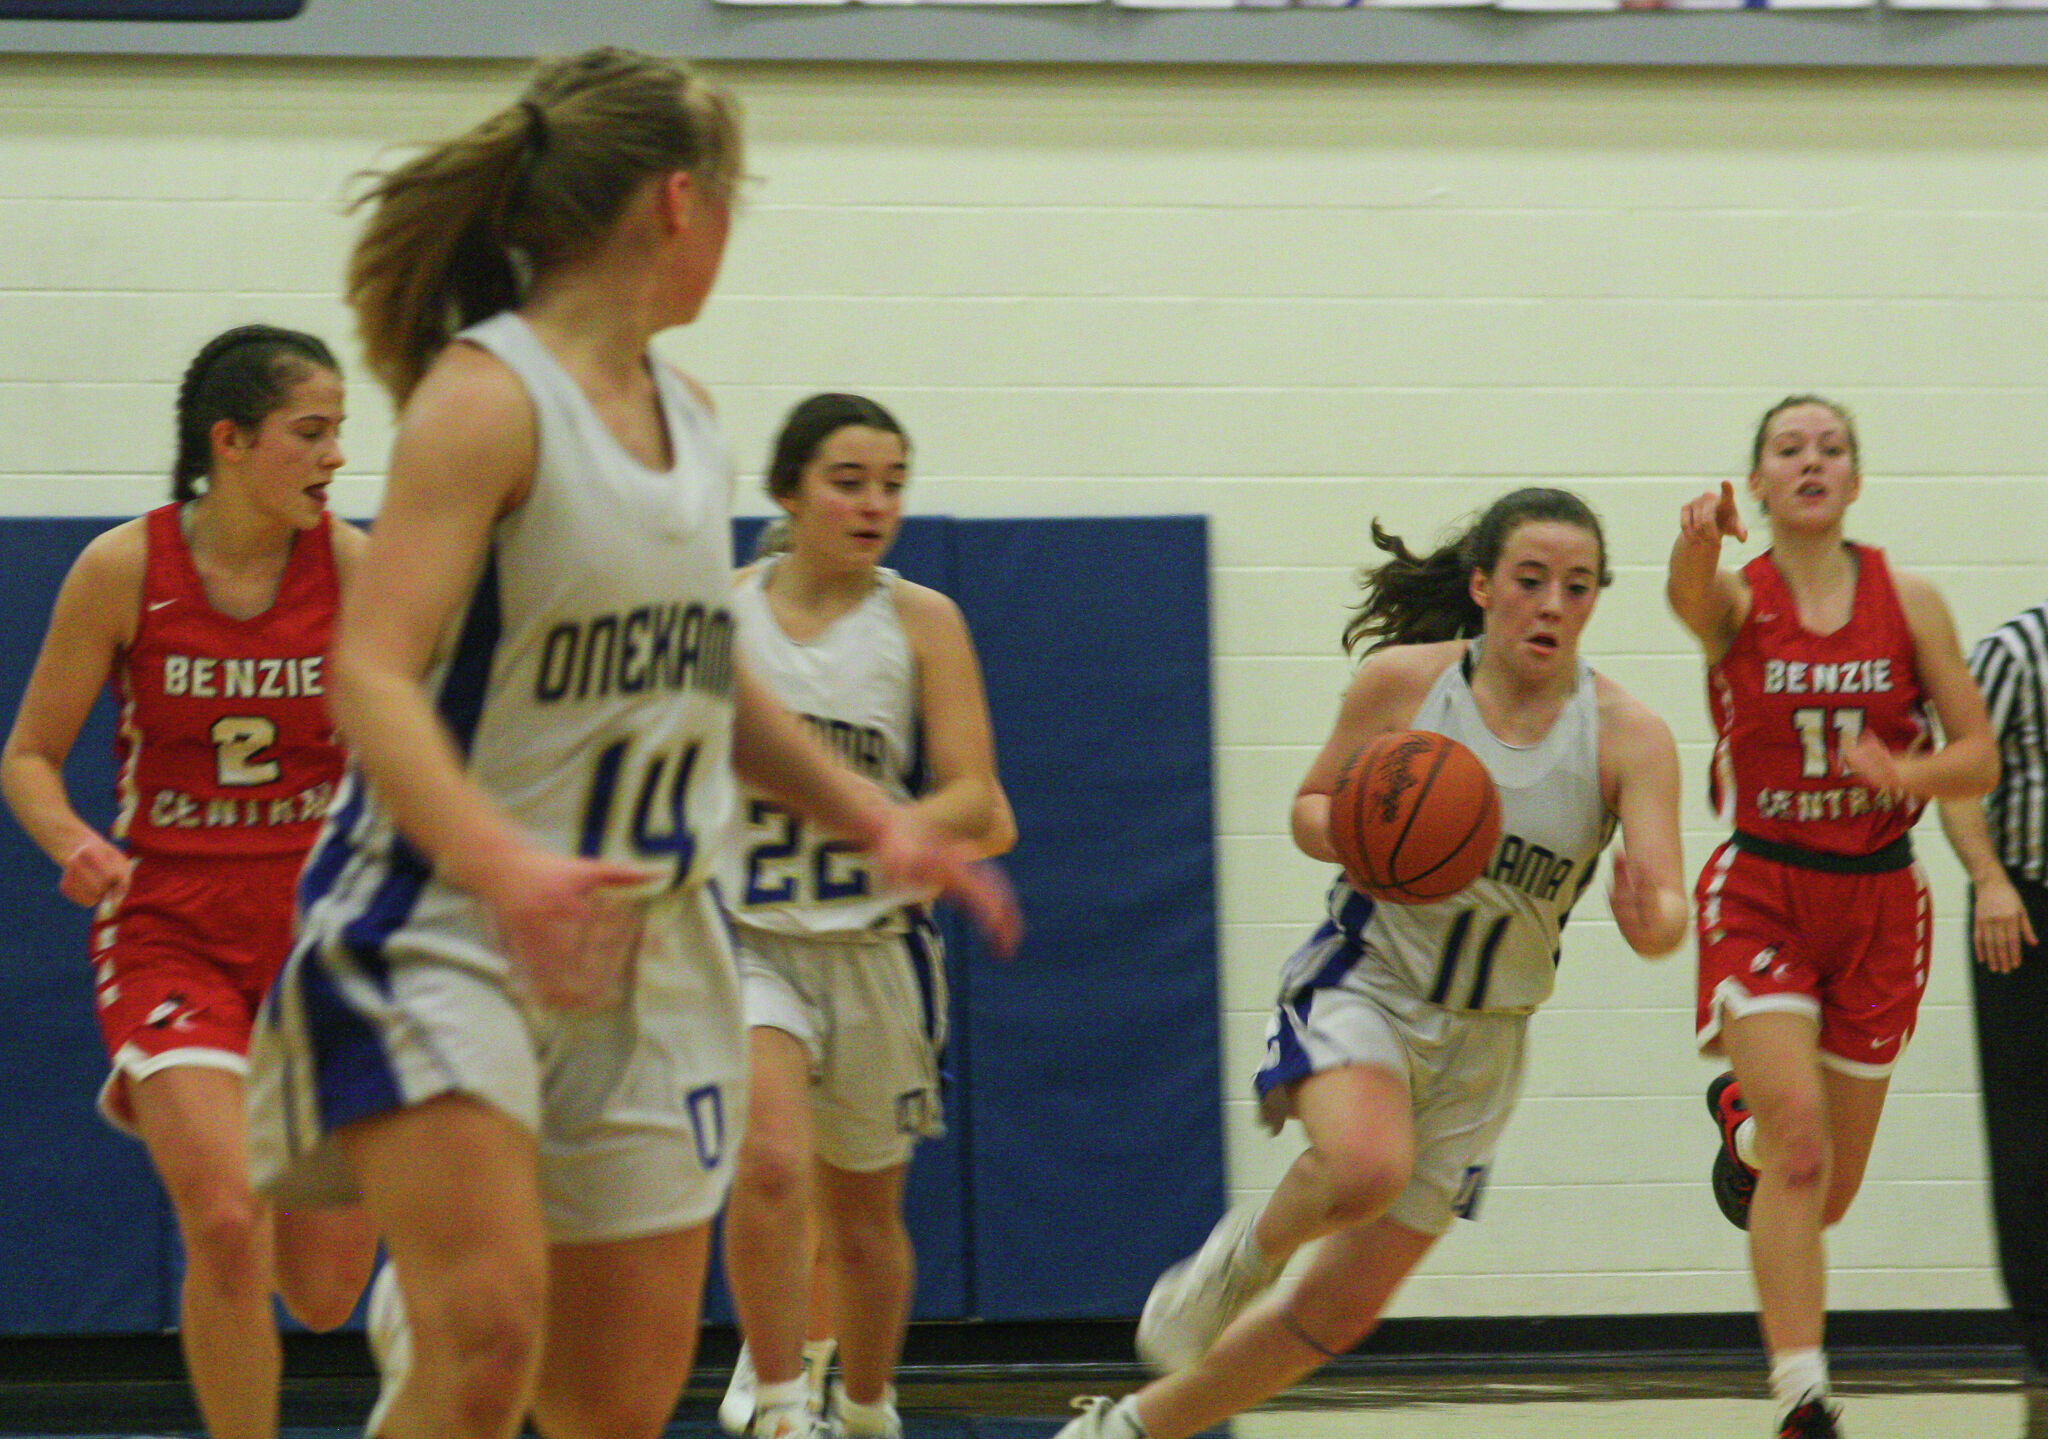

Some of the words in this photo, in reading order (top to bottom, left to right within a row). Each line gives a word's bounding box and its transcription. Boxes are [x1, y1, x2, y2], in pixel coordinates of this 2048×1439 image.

[163, 655, 324, 697] BENZIE
[1763, 659, 1895, 694] BENZIE
[209, 715, 279, 786] 2
[579, 736, 699, 888] 14
[746, 801, 871, 903] 22
[1430, 908, 1514, 1010] 11
